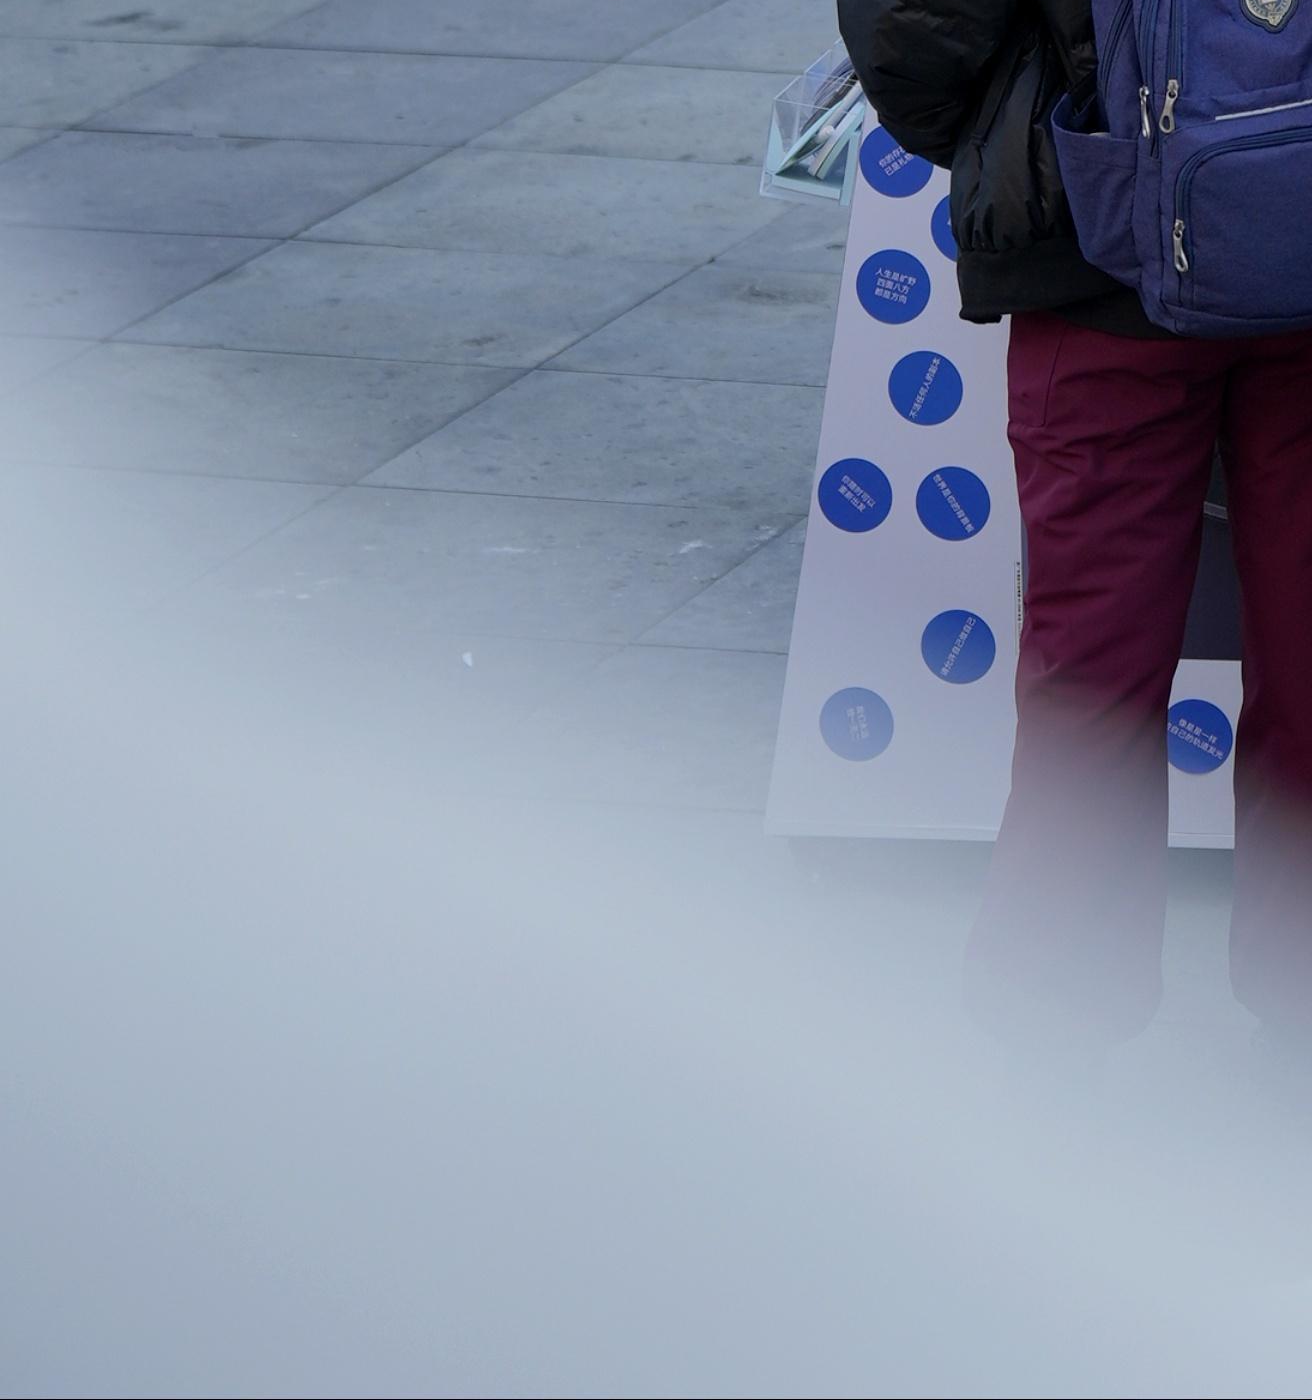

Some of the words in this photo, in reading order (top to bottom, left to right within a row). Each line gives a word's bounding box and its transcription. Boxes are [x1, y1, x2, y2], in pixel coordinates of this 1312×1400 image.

[876, 267, 916, 287] 人生是旷野
[877, 277, 909, 295] 四面八方
[874, 287, 907, 304] 都是方向
[1178, 718, 1218, 744] 像星星一样
